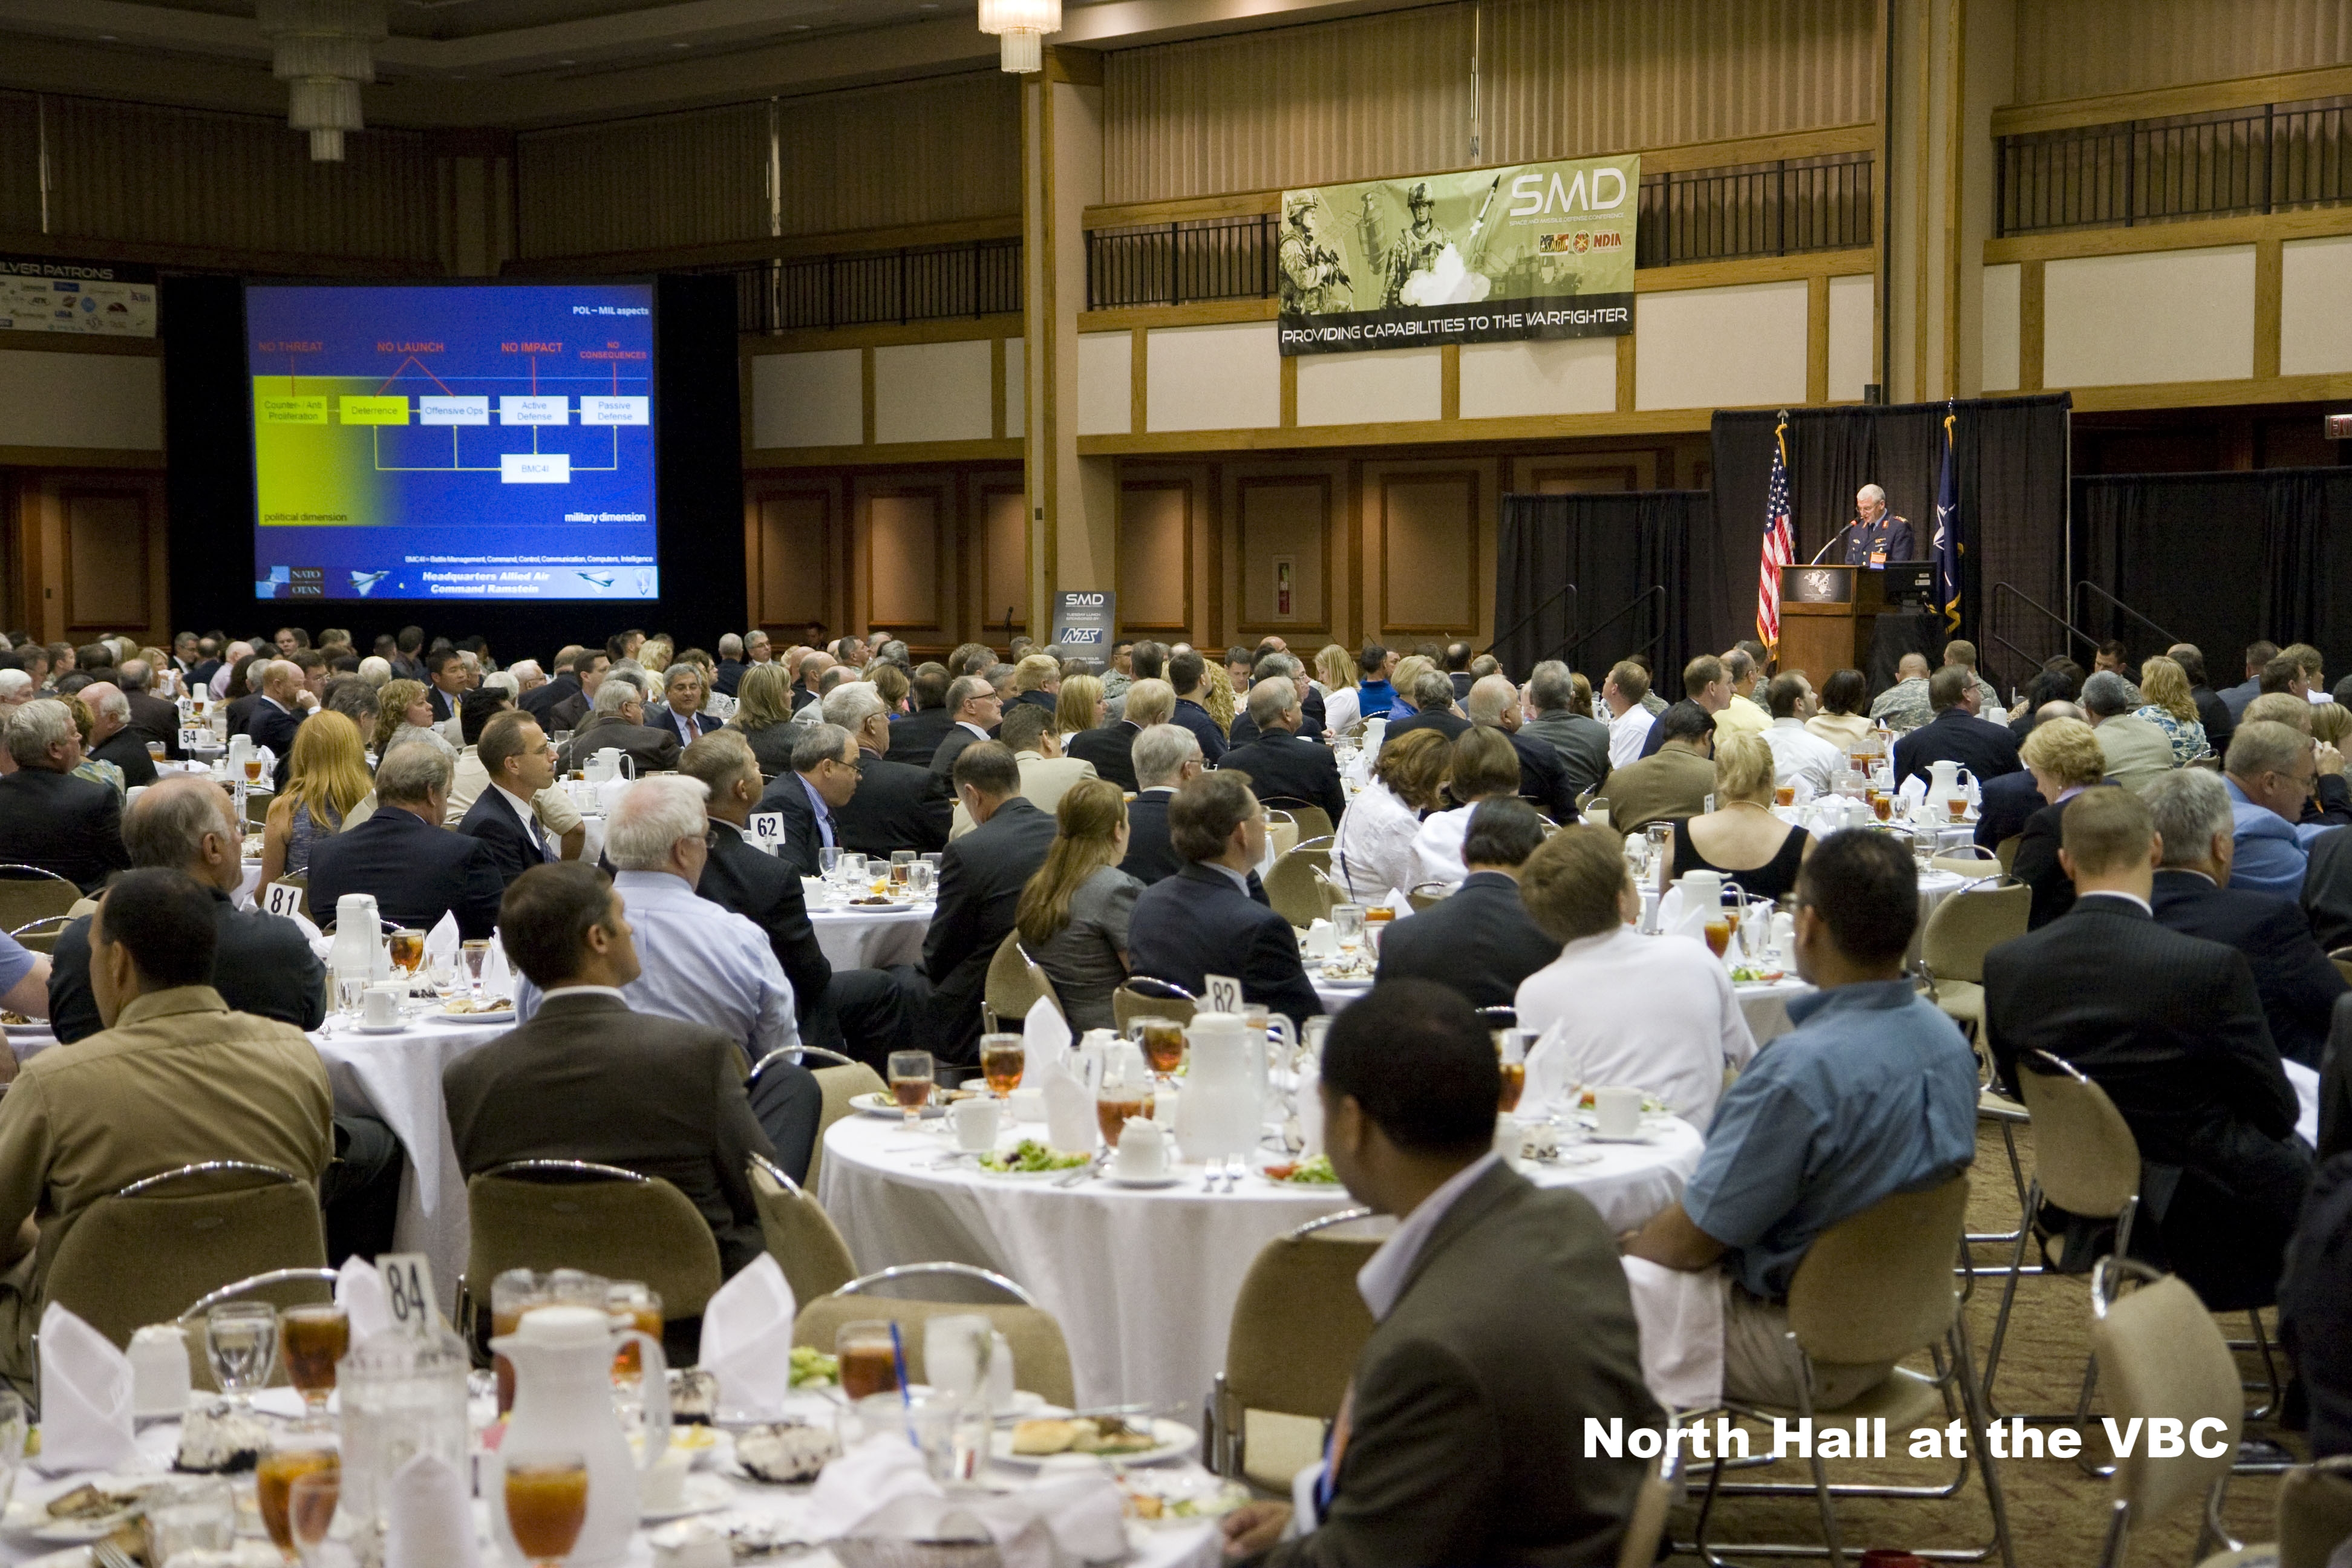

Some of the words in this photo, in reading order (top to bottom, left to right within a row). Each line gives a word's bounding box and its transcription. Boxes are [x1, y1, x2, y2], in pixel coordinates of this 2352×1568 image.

[1510, 168, 1627, 217] SMD
[1589, 212, 1624, 221] CONFERENCE
[1593, 233, 1622, 247] NDIA
[44, 264, 114, 280] PATRONS
[573, 306, 590, 315] POL
[599, 306, 616, 315] MIL
[617, 307, 649, 316] aspects
[1282, 325, 1361, 343] PROVIDING
[1364, 318, 1465, 338] CAPABILITIES
[1468, 316, 1489, 330] TO
[1492, 313, 1522, 329] THE
[1526, 307, 1628, 326] WARFIGHTER
[259, 342, 275, 351] NO
[279, 342, 323, 351] THREAT
[377, 342, 394, 352] NO
[397, 342, 444, 352] LAUNCH
[501, 342, 518, 352] NO
[521, 342, 563, 352] IMPACT
[307, 401, 322, 410] Anti
[598, 401, 630, 410] Passive
[269, 411, 318, 420] Proliferation
[466, 407, 483, 416] Ops
[598, 412, 632, 420] Defense
[264, 512, 298, 522] political
[301, 512, 347, 521] dimension
[565, 512, 598, 523] military
[598, 512, 646, 522] dimension
[292, 570, 321, 578] NATO
[423, 572, 497, 583] Headquarters
[499, 572, 531, 581] Allied
[532, 571, 550, 581] Air
[292, 586, 321, 594] OTAN
[431, 584, 485, 593] Command
[487, 584, 539, 593] Ramstein
[1065, 593, 1104, 605] SMD
[1061, 628, 1100, 643] NTS
[181, 701, 191, 711] 42
[183, 730, 197, 743] 54
[237, 780, 244, 797] 63
[757, 817, 777, 837] 62
[271, 887, 295, 915] 81
[1213, 982, 1235, 1013] 82
[388, 1263, 425, 1322] 84
